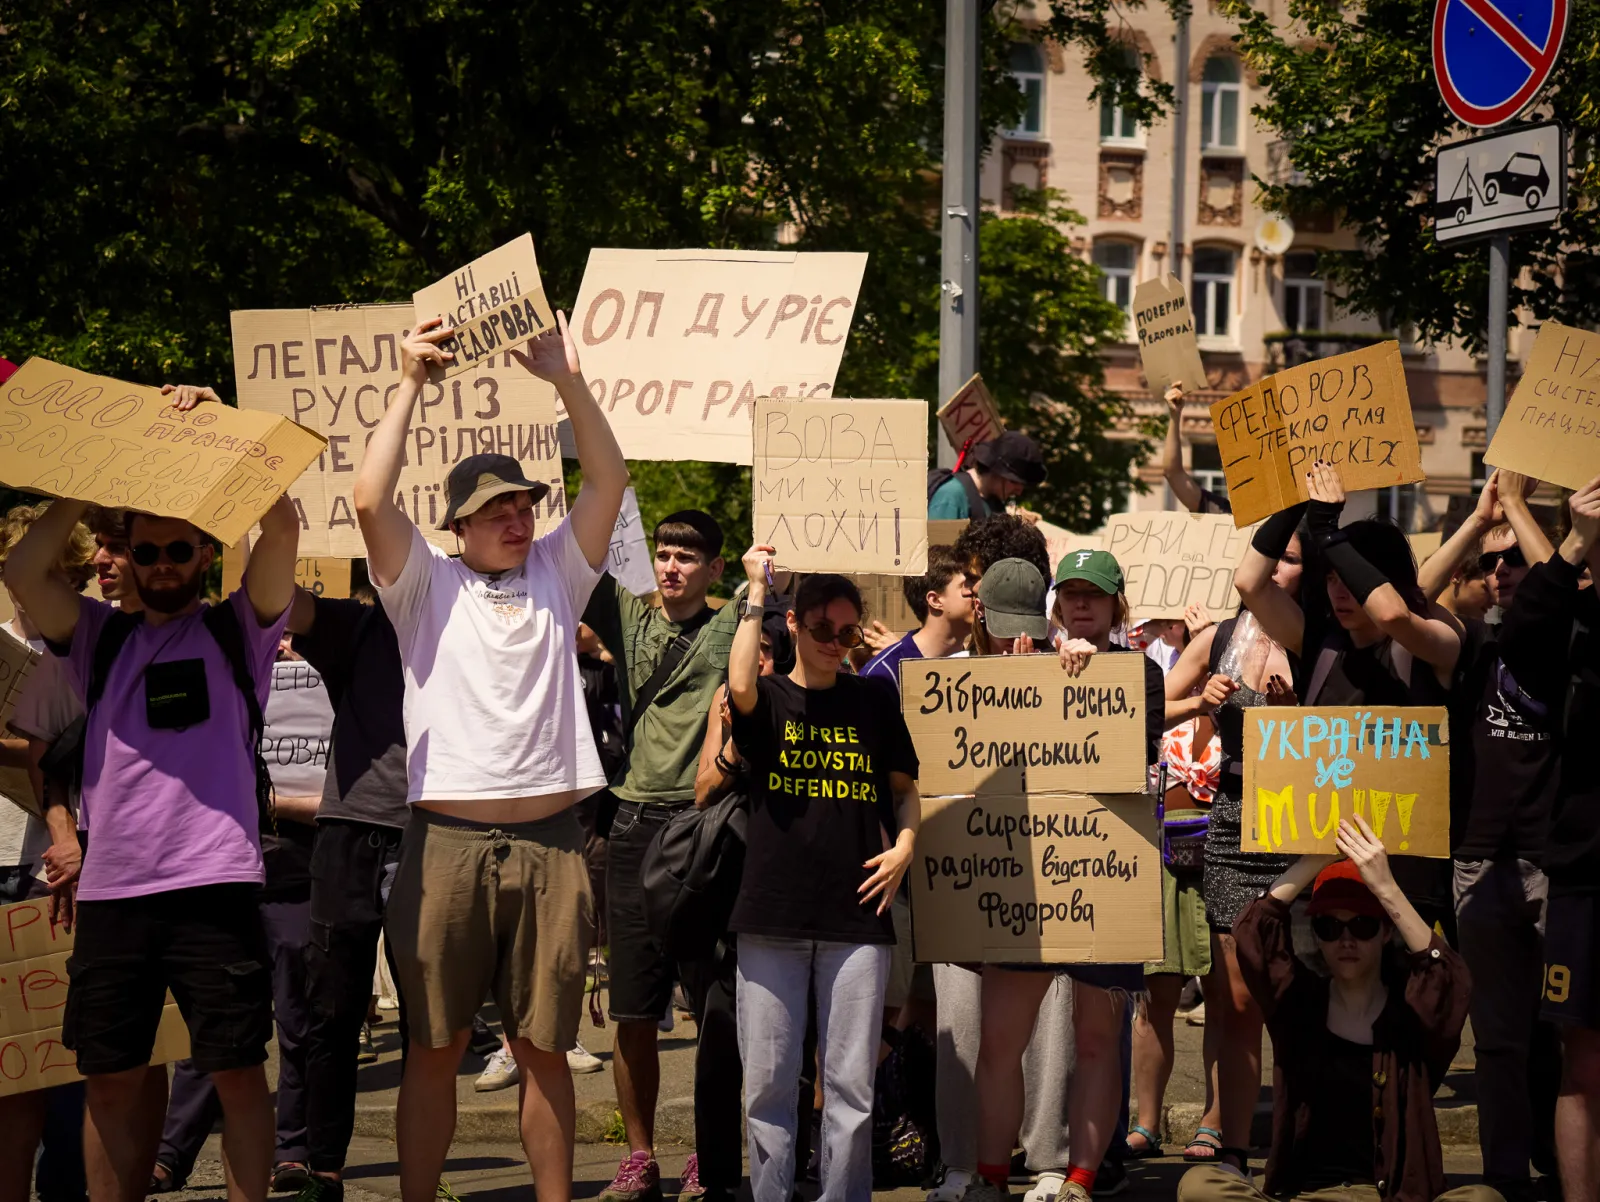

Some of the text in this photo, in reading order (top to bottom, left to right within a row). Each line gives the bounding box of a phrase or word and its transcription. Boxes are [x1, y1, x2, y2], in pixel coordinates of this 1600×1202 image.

[427, 271, 521, 333] ДСТАВЦІ
[455, 265, 476, 300] НІ
[582, 288, 852, 346] ОП ДУРІЄ
[1136, 296, 1186, 328] ПОВЕРНИ
[1219, 364, 1373, 442] ФЕДОРОВ
[1534, 378, 1600, 409] СИСТЕ
[1256, 406, 1386, 461] ПЕКЛО ДЛЯ
[759, 477, 805, 502] МИ
[826, 476, 845, 502] Ж
[1109, 520, 1188, 557] РУКИ
[920, 672, 1136, 720] Зібрались русня,
[810, 725, 860, 744] FREE
[948, 726, 1100, 769] Зеленський
[1257, 711, 1431, 761] УКРАЇНА
[778, 750, 874, 774] AZOVSTAL
[768, 772, 878, 803] DEFENDERS
[966, 807, 1109, 850] Сирський,
[925, 845, 1138, 890] радіють відставці
[978, 889, 1095, 936] Федорова
